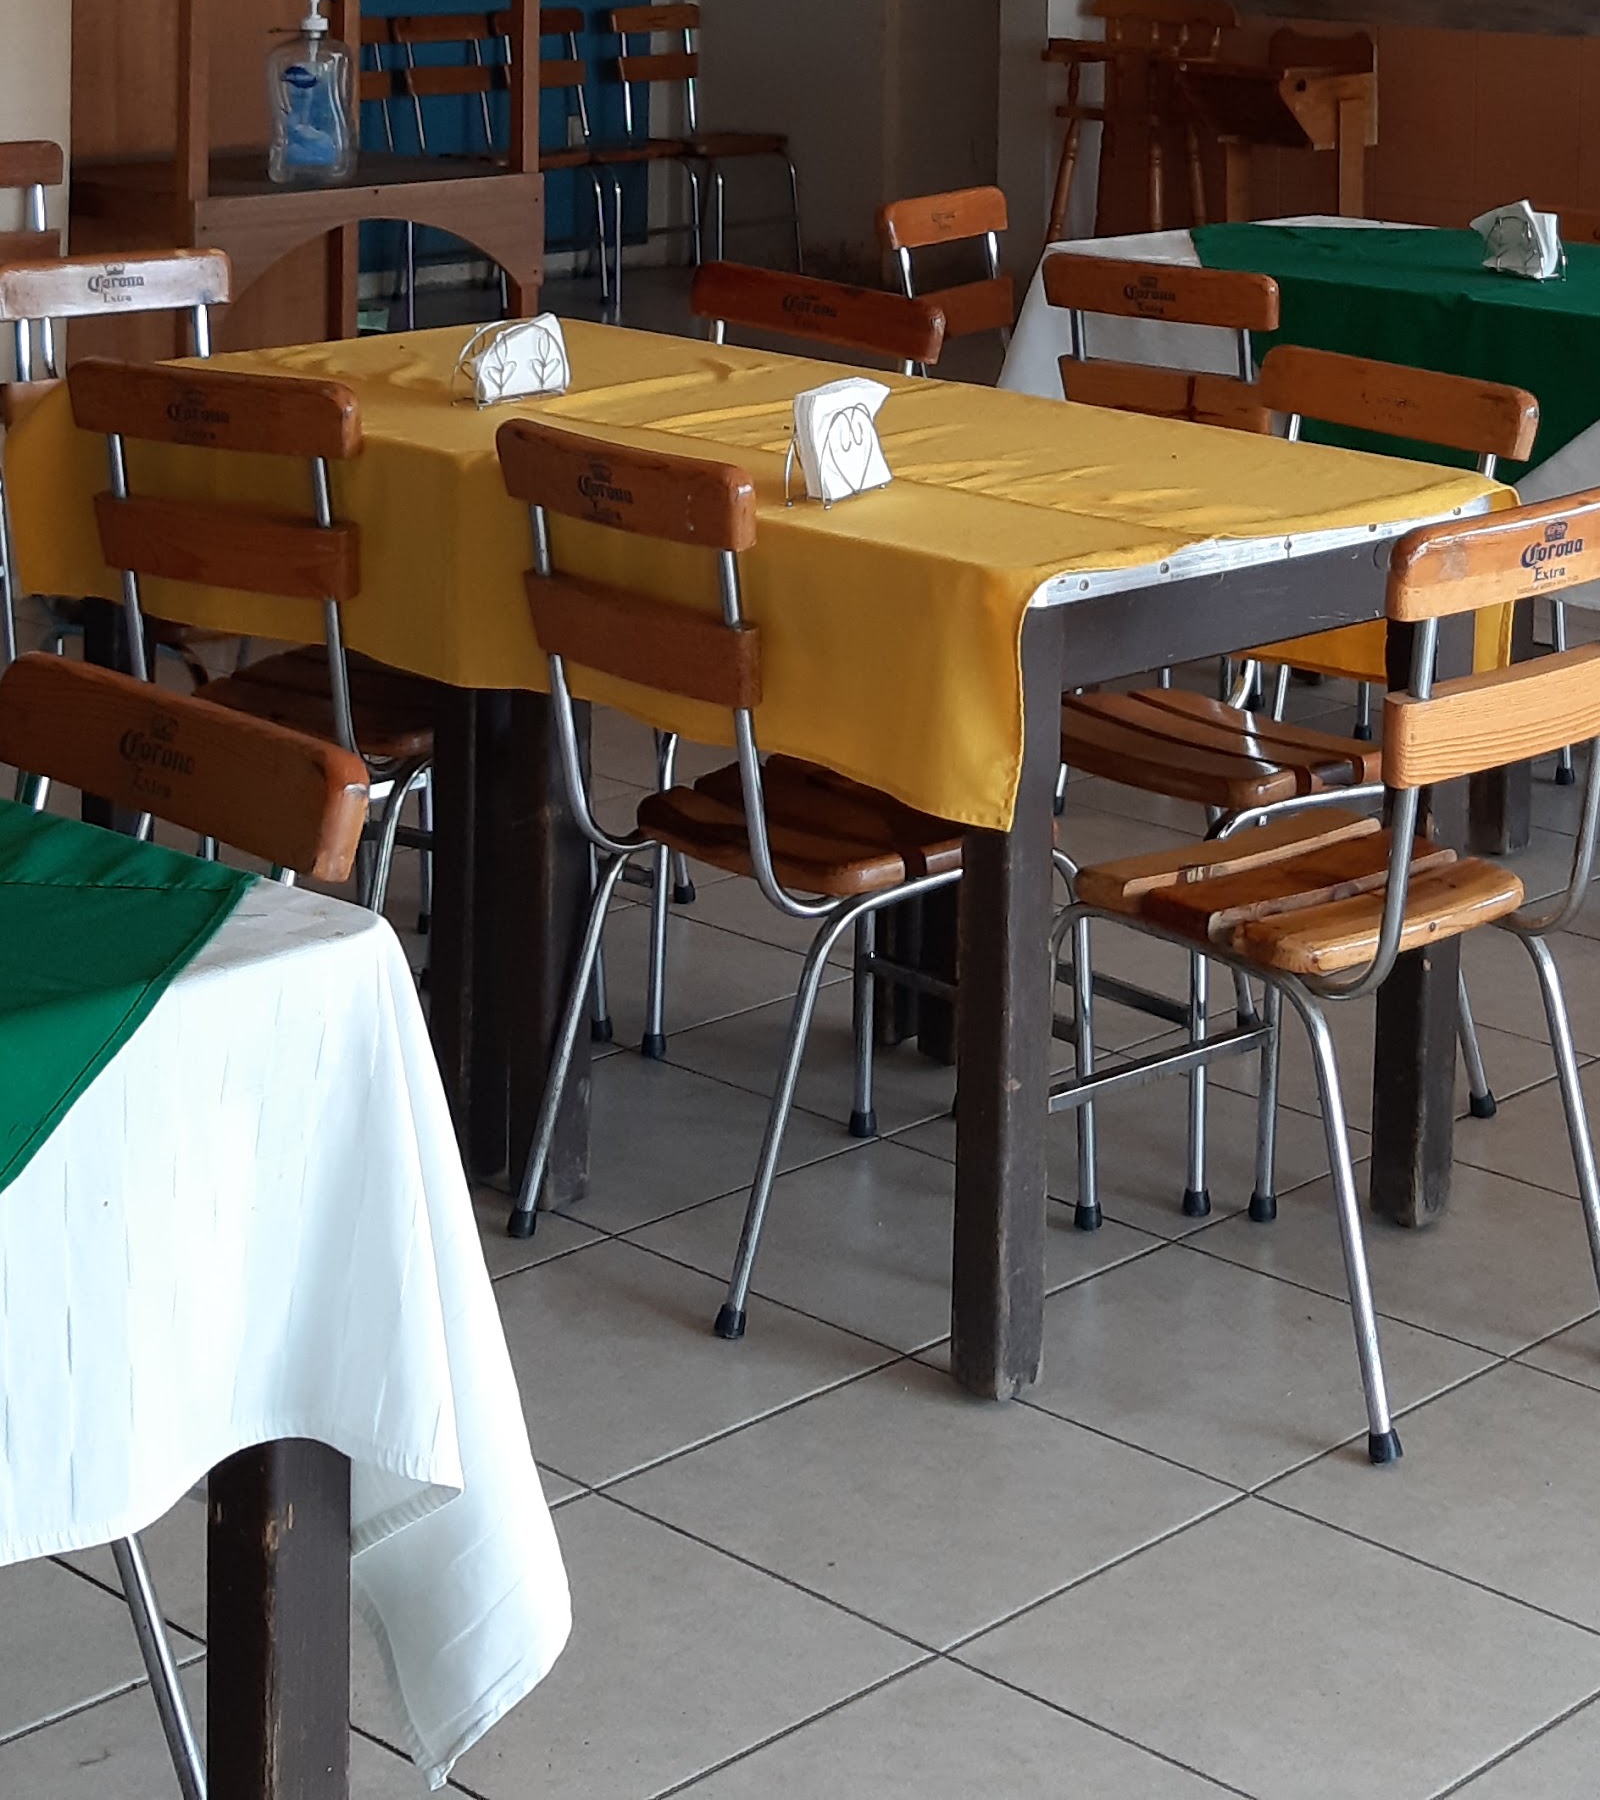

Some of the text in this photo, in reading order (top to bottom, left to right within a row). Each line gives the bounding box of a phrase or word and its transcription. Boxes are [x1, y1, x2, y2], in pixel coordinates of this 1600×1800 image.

[87, 274, 145, 294] Corona
[1520, 538, 1584, 569] Corona
[1533, 566, 1566, 583] Extra
[119, 729, 196, 777] Corona
